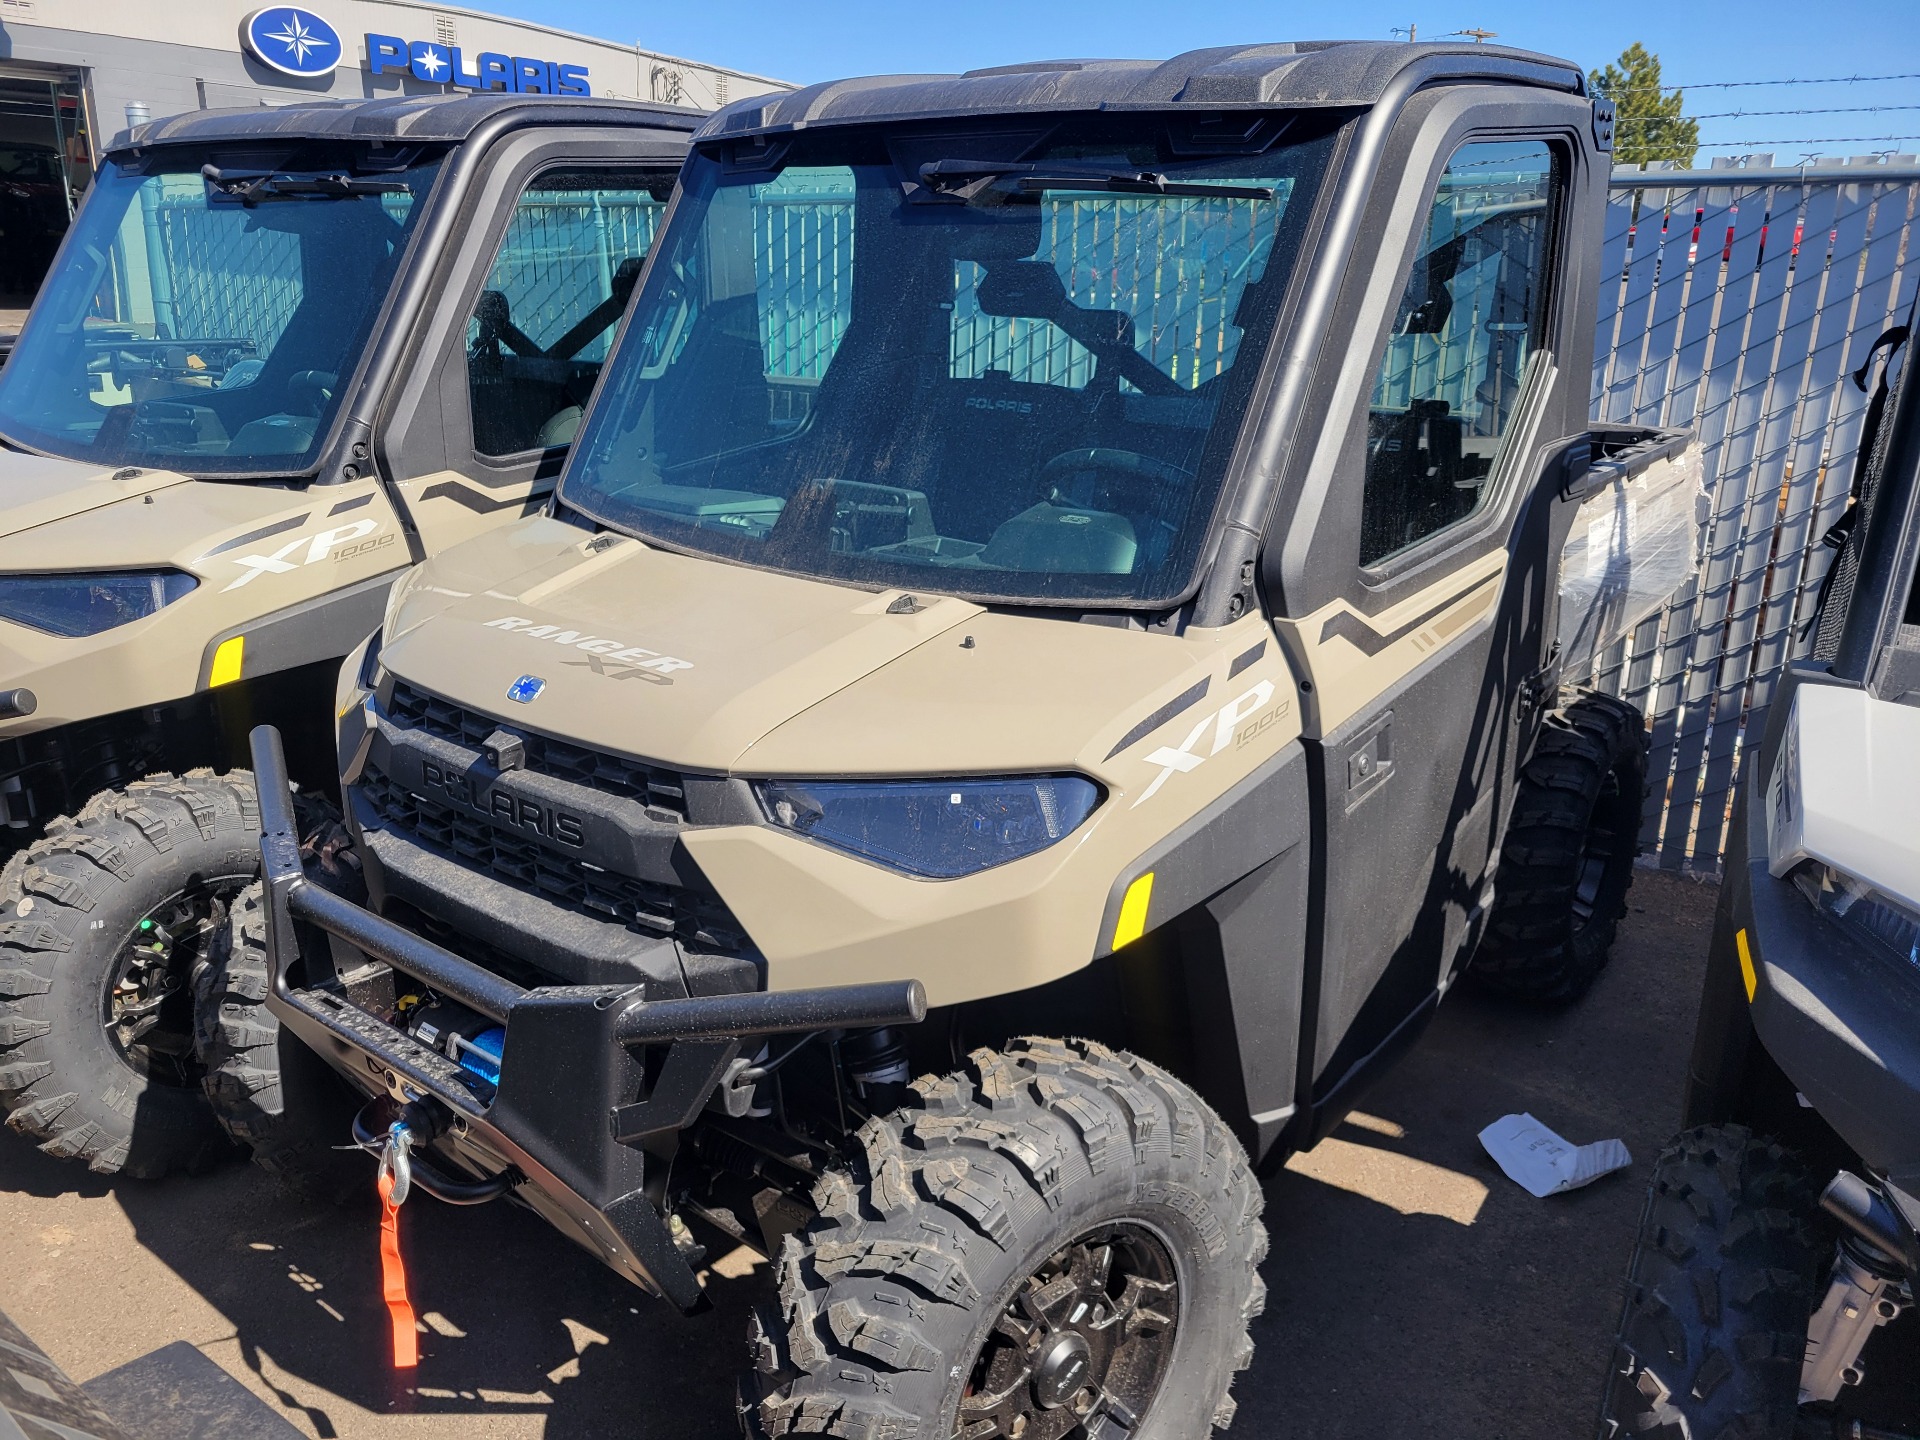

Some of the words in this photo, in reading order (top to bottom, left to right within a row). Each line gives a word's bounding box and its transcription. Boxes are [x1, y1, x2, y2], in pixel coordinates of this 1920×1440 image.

[365, 33, 591, 97] POLARIS
[965, 398, 1033, 414] POLARIS
[217, 518, 378, 594] XP
[333, 533, 395, 560] 1000
[482, 616, 695, 673] RANGER
[559, 653, 674, 686] XP
[1129, 679, 1275, 810] XP
[1235, 700, 1289, 745] 1000
[421, 760, 585, 849] POLARIS
